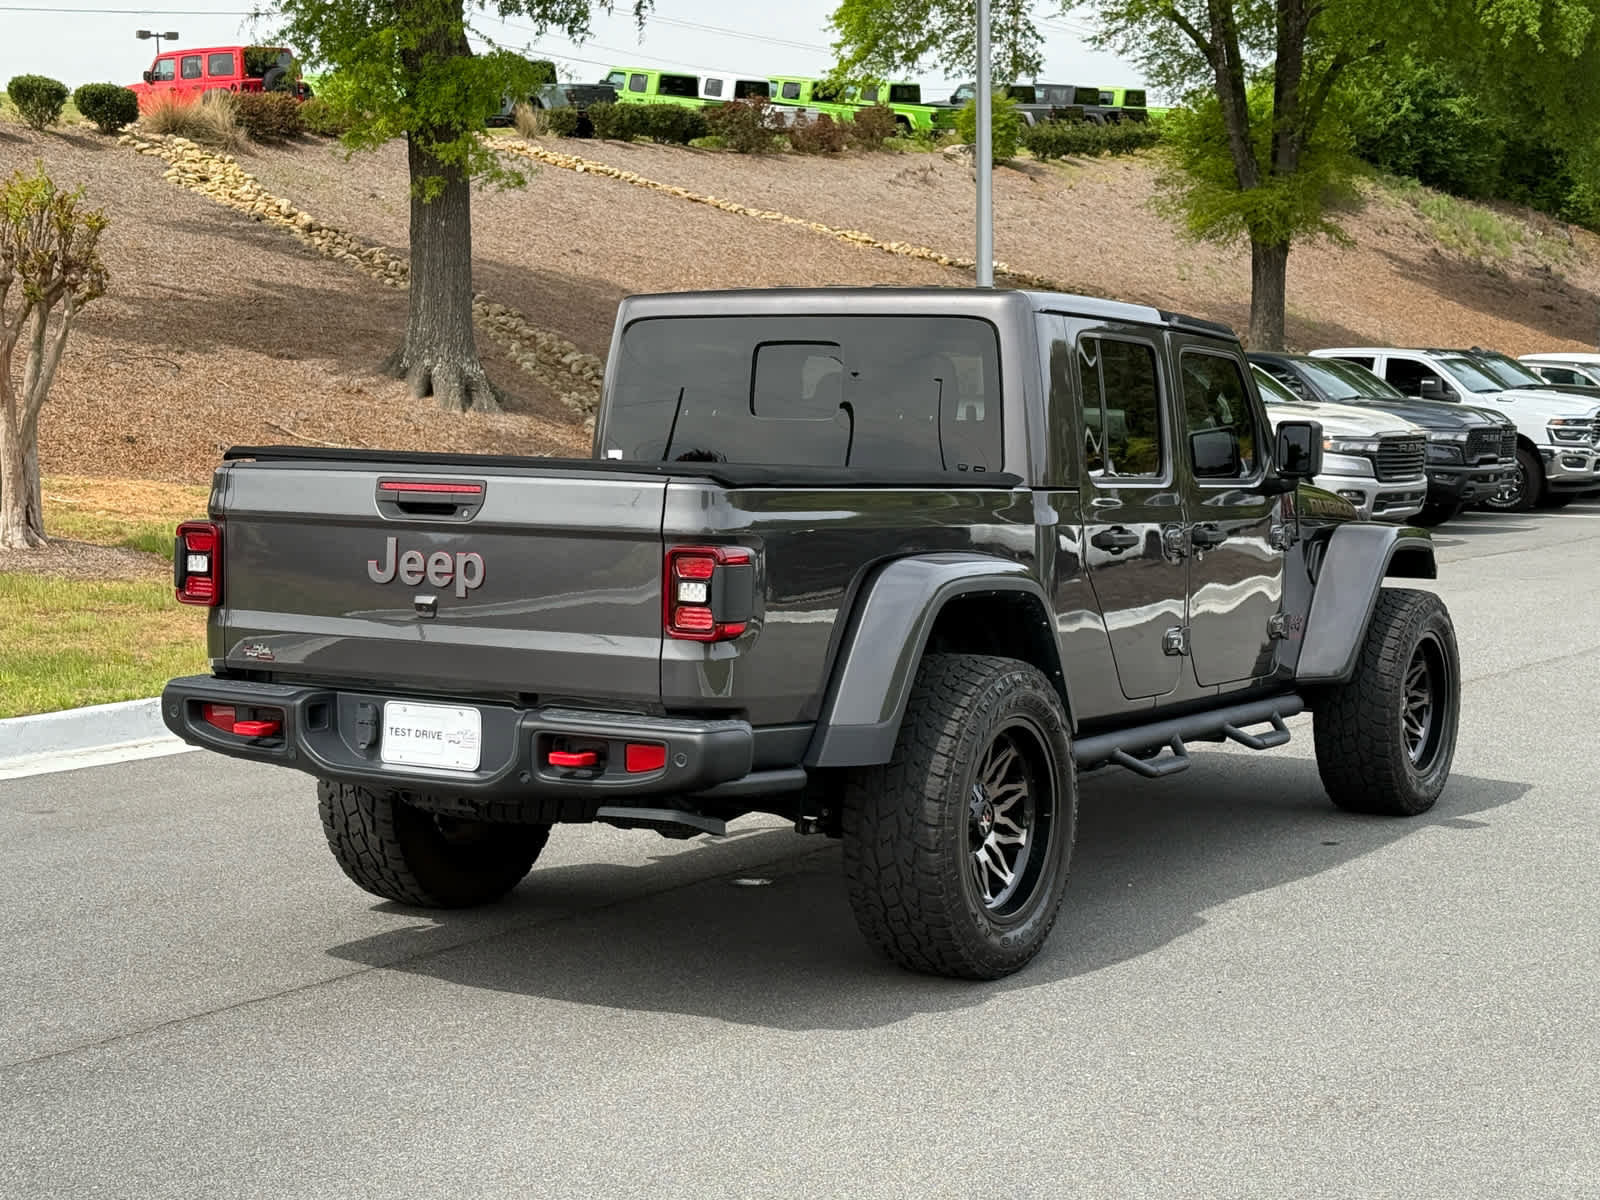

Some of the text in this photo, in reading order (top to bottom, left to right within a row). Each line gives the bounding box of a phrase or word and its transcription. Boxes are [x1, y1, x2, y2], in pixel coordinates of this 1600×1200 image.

[367, 536, 486, 599] Jeep
[389, 727, 412, 737] TEST
[415, 728, 443, 741] DRIVE
